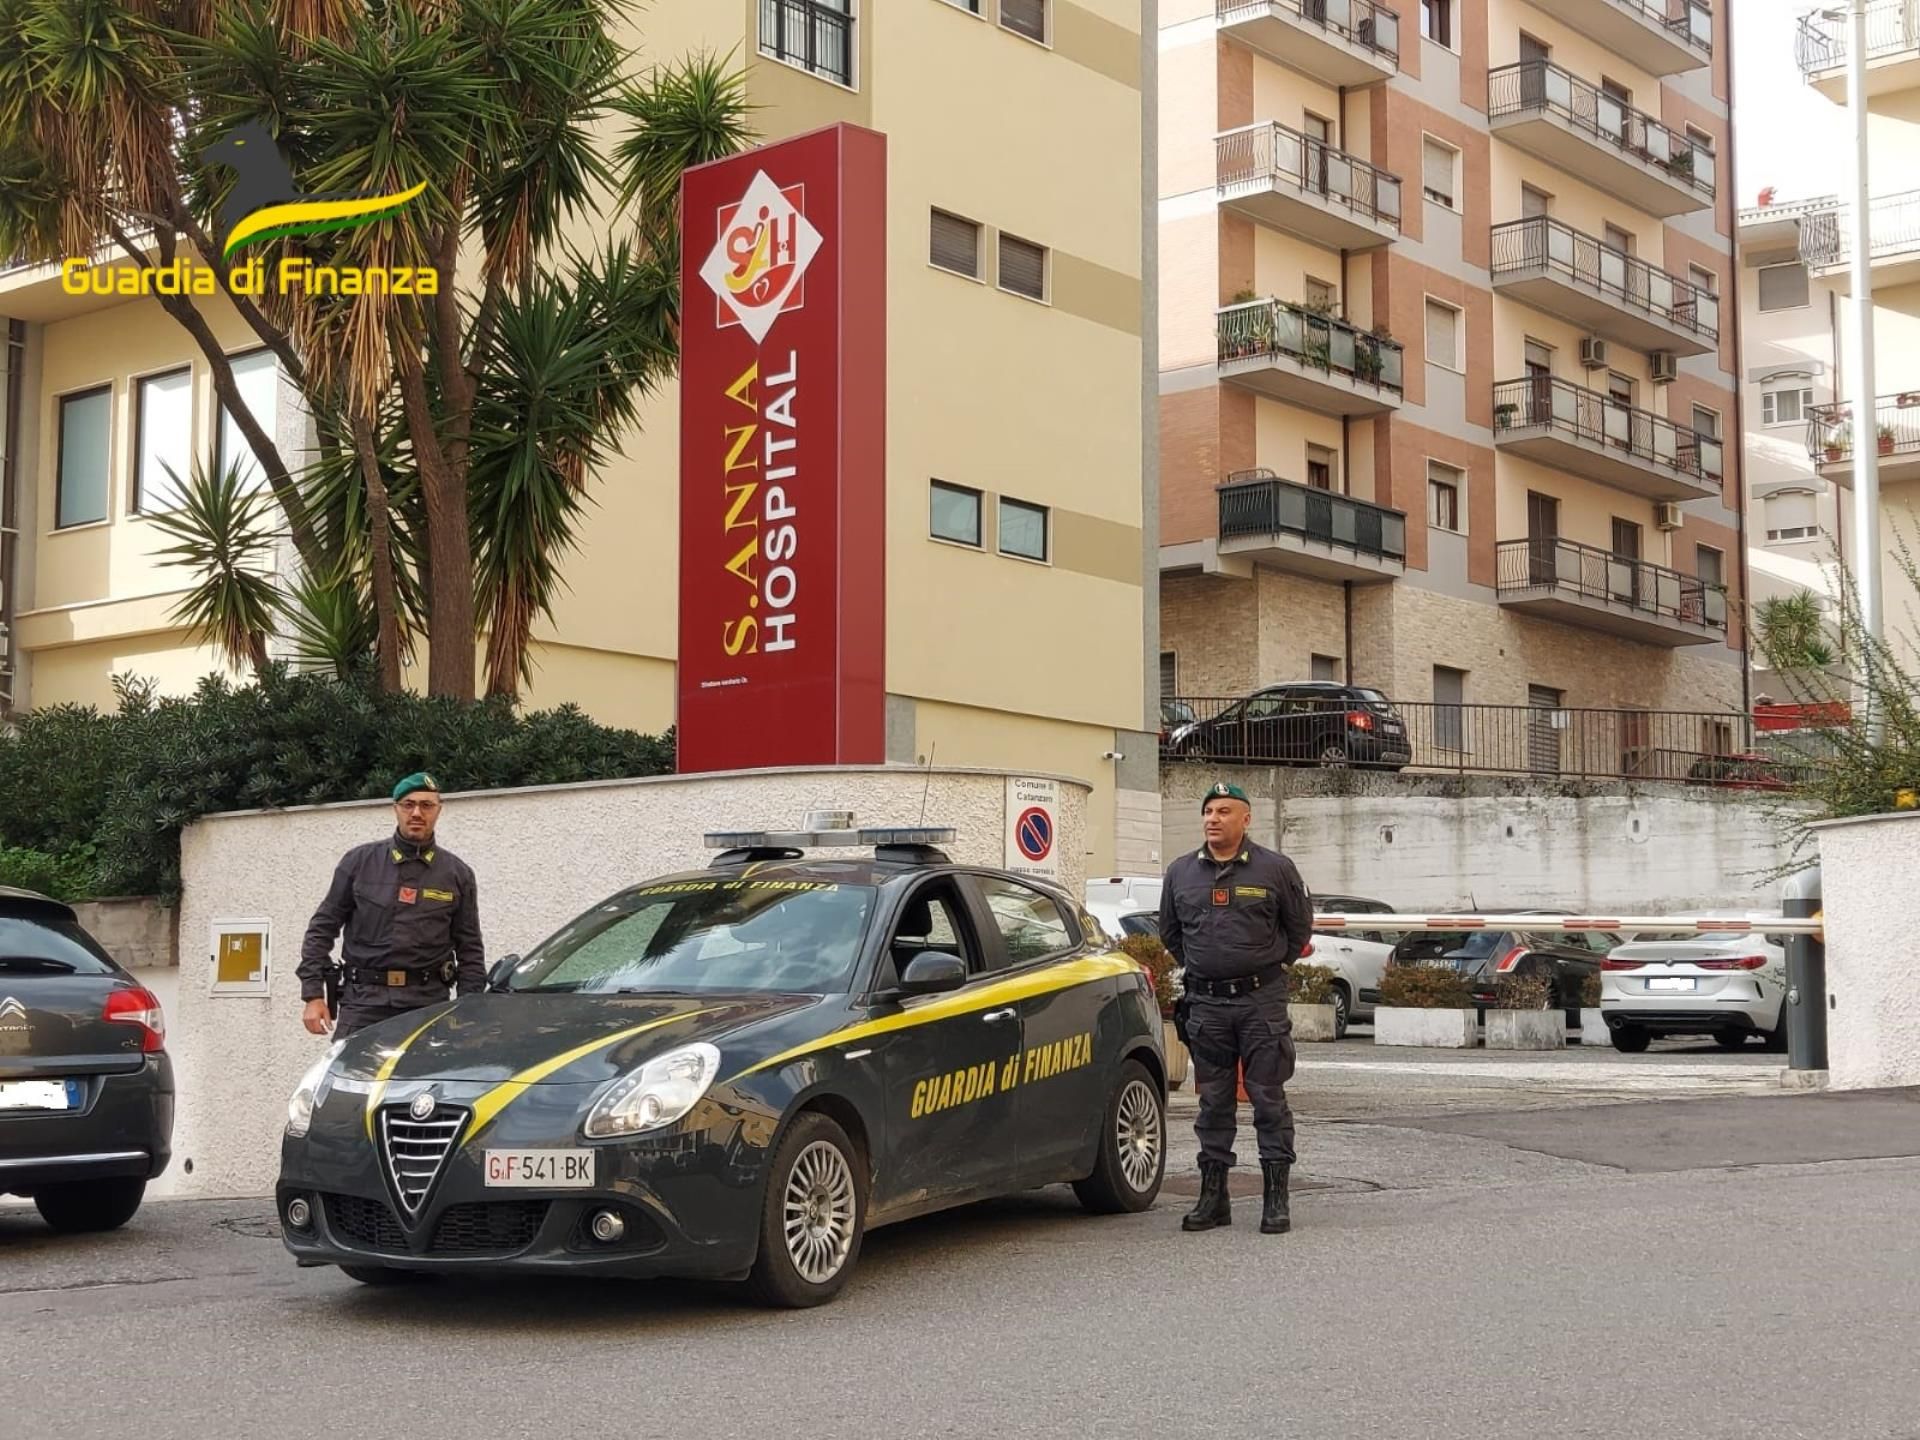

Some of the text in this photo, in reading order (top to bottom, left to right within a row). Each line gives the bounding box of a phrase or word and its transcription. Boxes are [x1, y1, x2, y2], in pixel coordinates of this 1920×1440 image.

[723, 359, 759, 656] S.ANNA
[765, 349, 798, 653] HOSPITAL
[639, 881, 839, 896] GUARDIA di FINANZA
[911, 1032, 1093, 1119] GUARDIA di FINANZA
[522, 1156, 556, 1180] 541
[565, 1156, 590, 1180] BK
